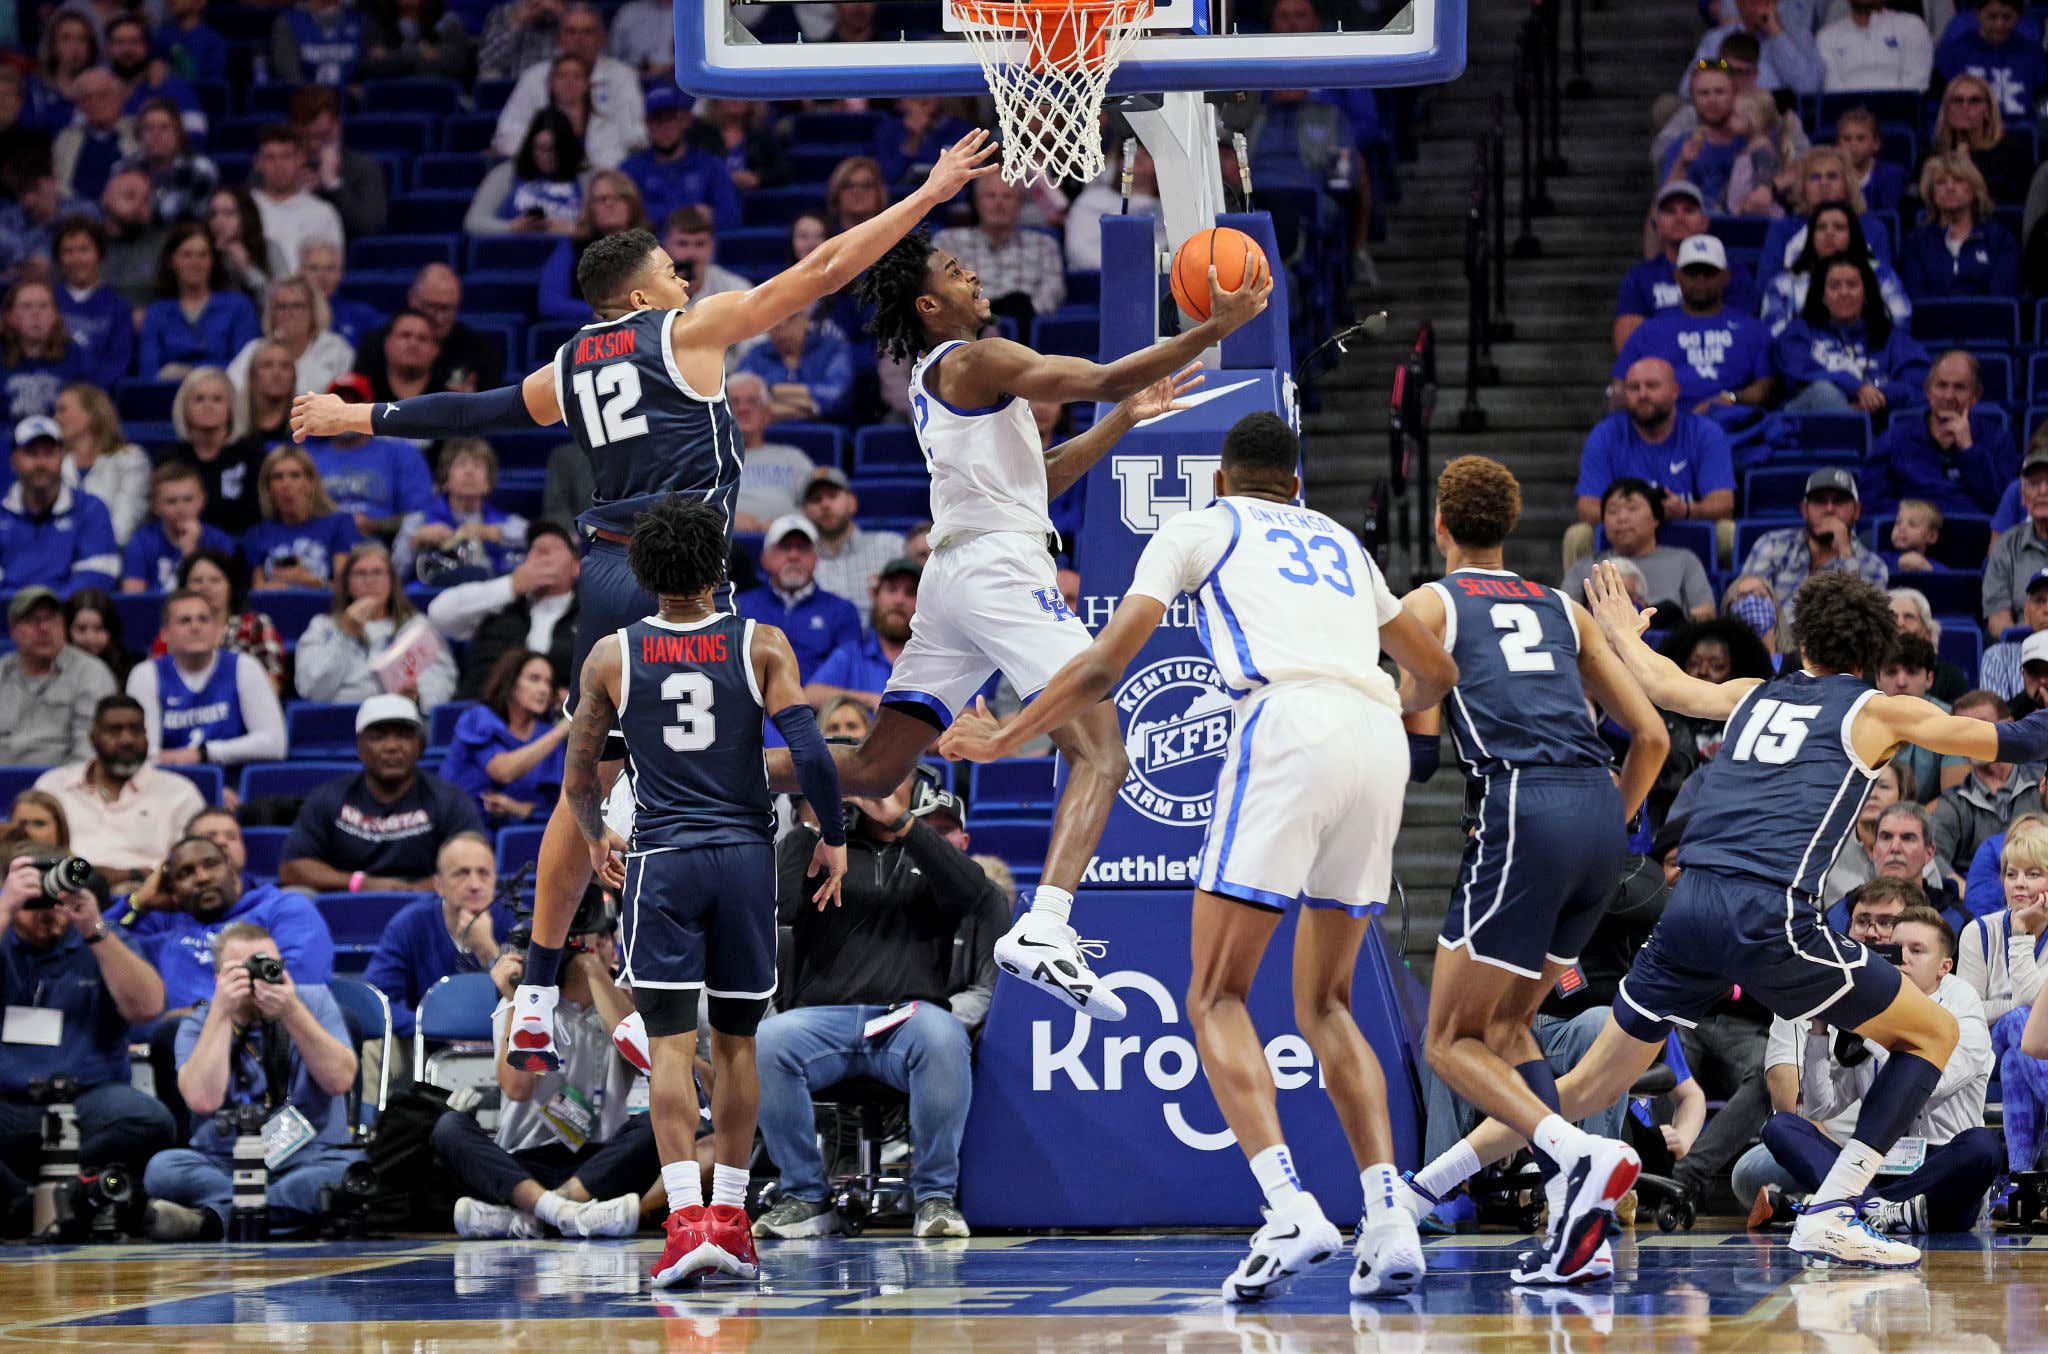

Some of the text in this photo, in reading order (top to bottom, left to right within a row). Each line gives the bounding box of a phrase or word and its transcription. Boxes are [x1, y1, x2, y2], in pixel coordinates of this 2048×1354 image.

[572, 361, 650, 449] 12
[1265, 528, 1356, 598] 33
[642, 633, 729, 665] HAWKINS
[1489, 602, 1556, 673] 2
[660, 671, 717, 753] 3
[1117, 662, 1226, 714] KENTUCK
[1151, 714, 1228, 768] KFB
[1731, 698, 1824, 765] 15
[1080, 854, 1201, 883] Kathlet
[1032, 969, 1328, 1151] Kroe
